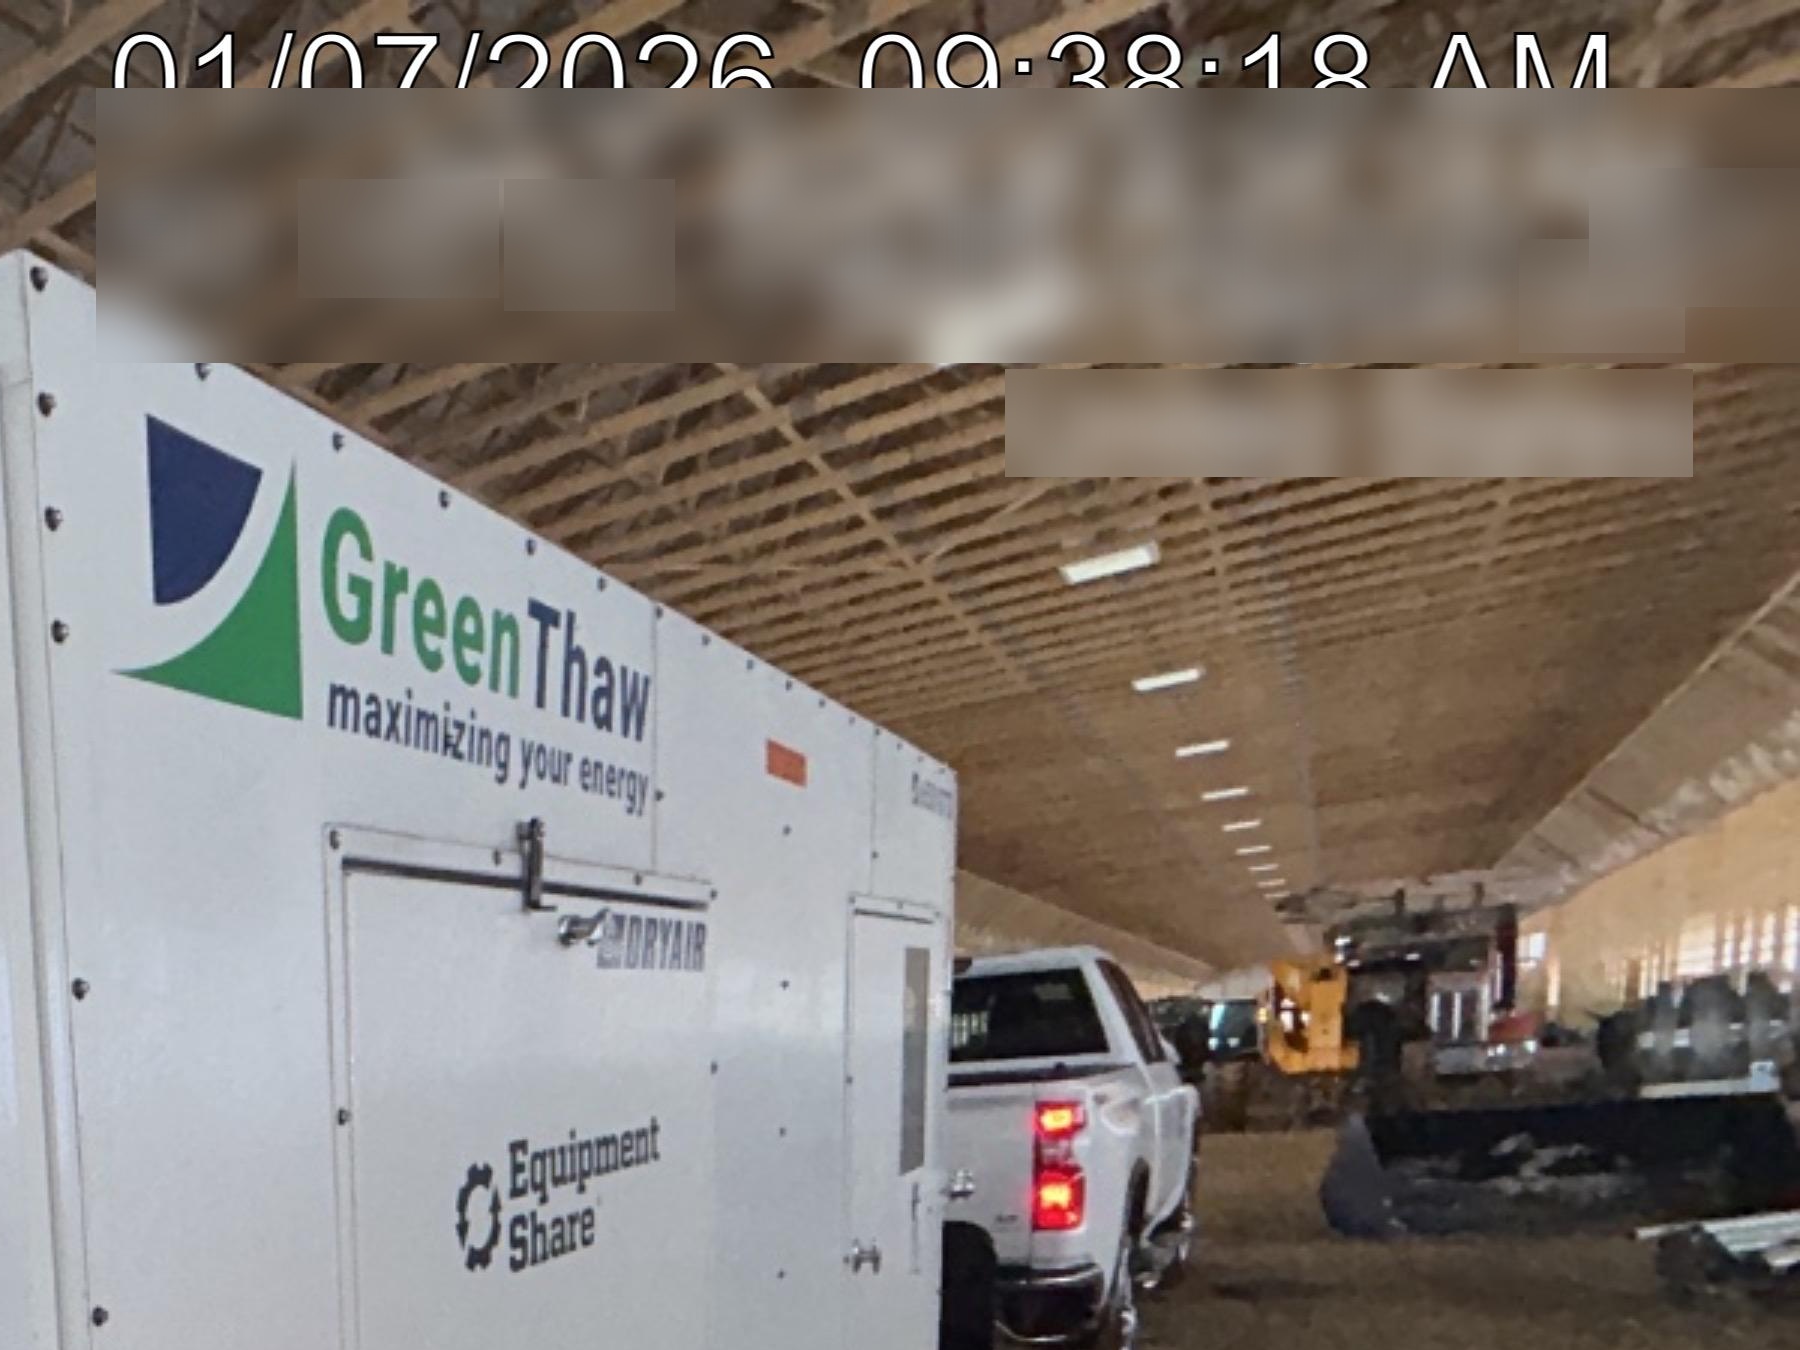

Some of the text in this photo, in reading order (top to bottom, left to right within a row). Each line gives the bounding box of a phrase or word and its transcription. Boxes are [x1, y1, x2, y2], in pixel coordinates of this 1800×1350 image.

[320, 505, 651, 743] GreenThaw
[326, 682, 649, 817] maximizing your energy
[623, 914, 707, 972] DRYAIR
[508, 1115, 660, 1206] Equipment
[508, 1205, 596, 1273] Share
